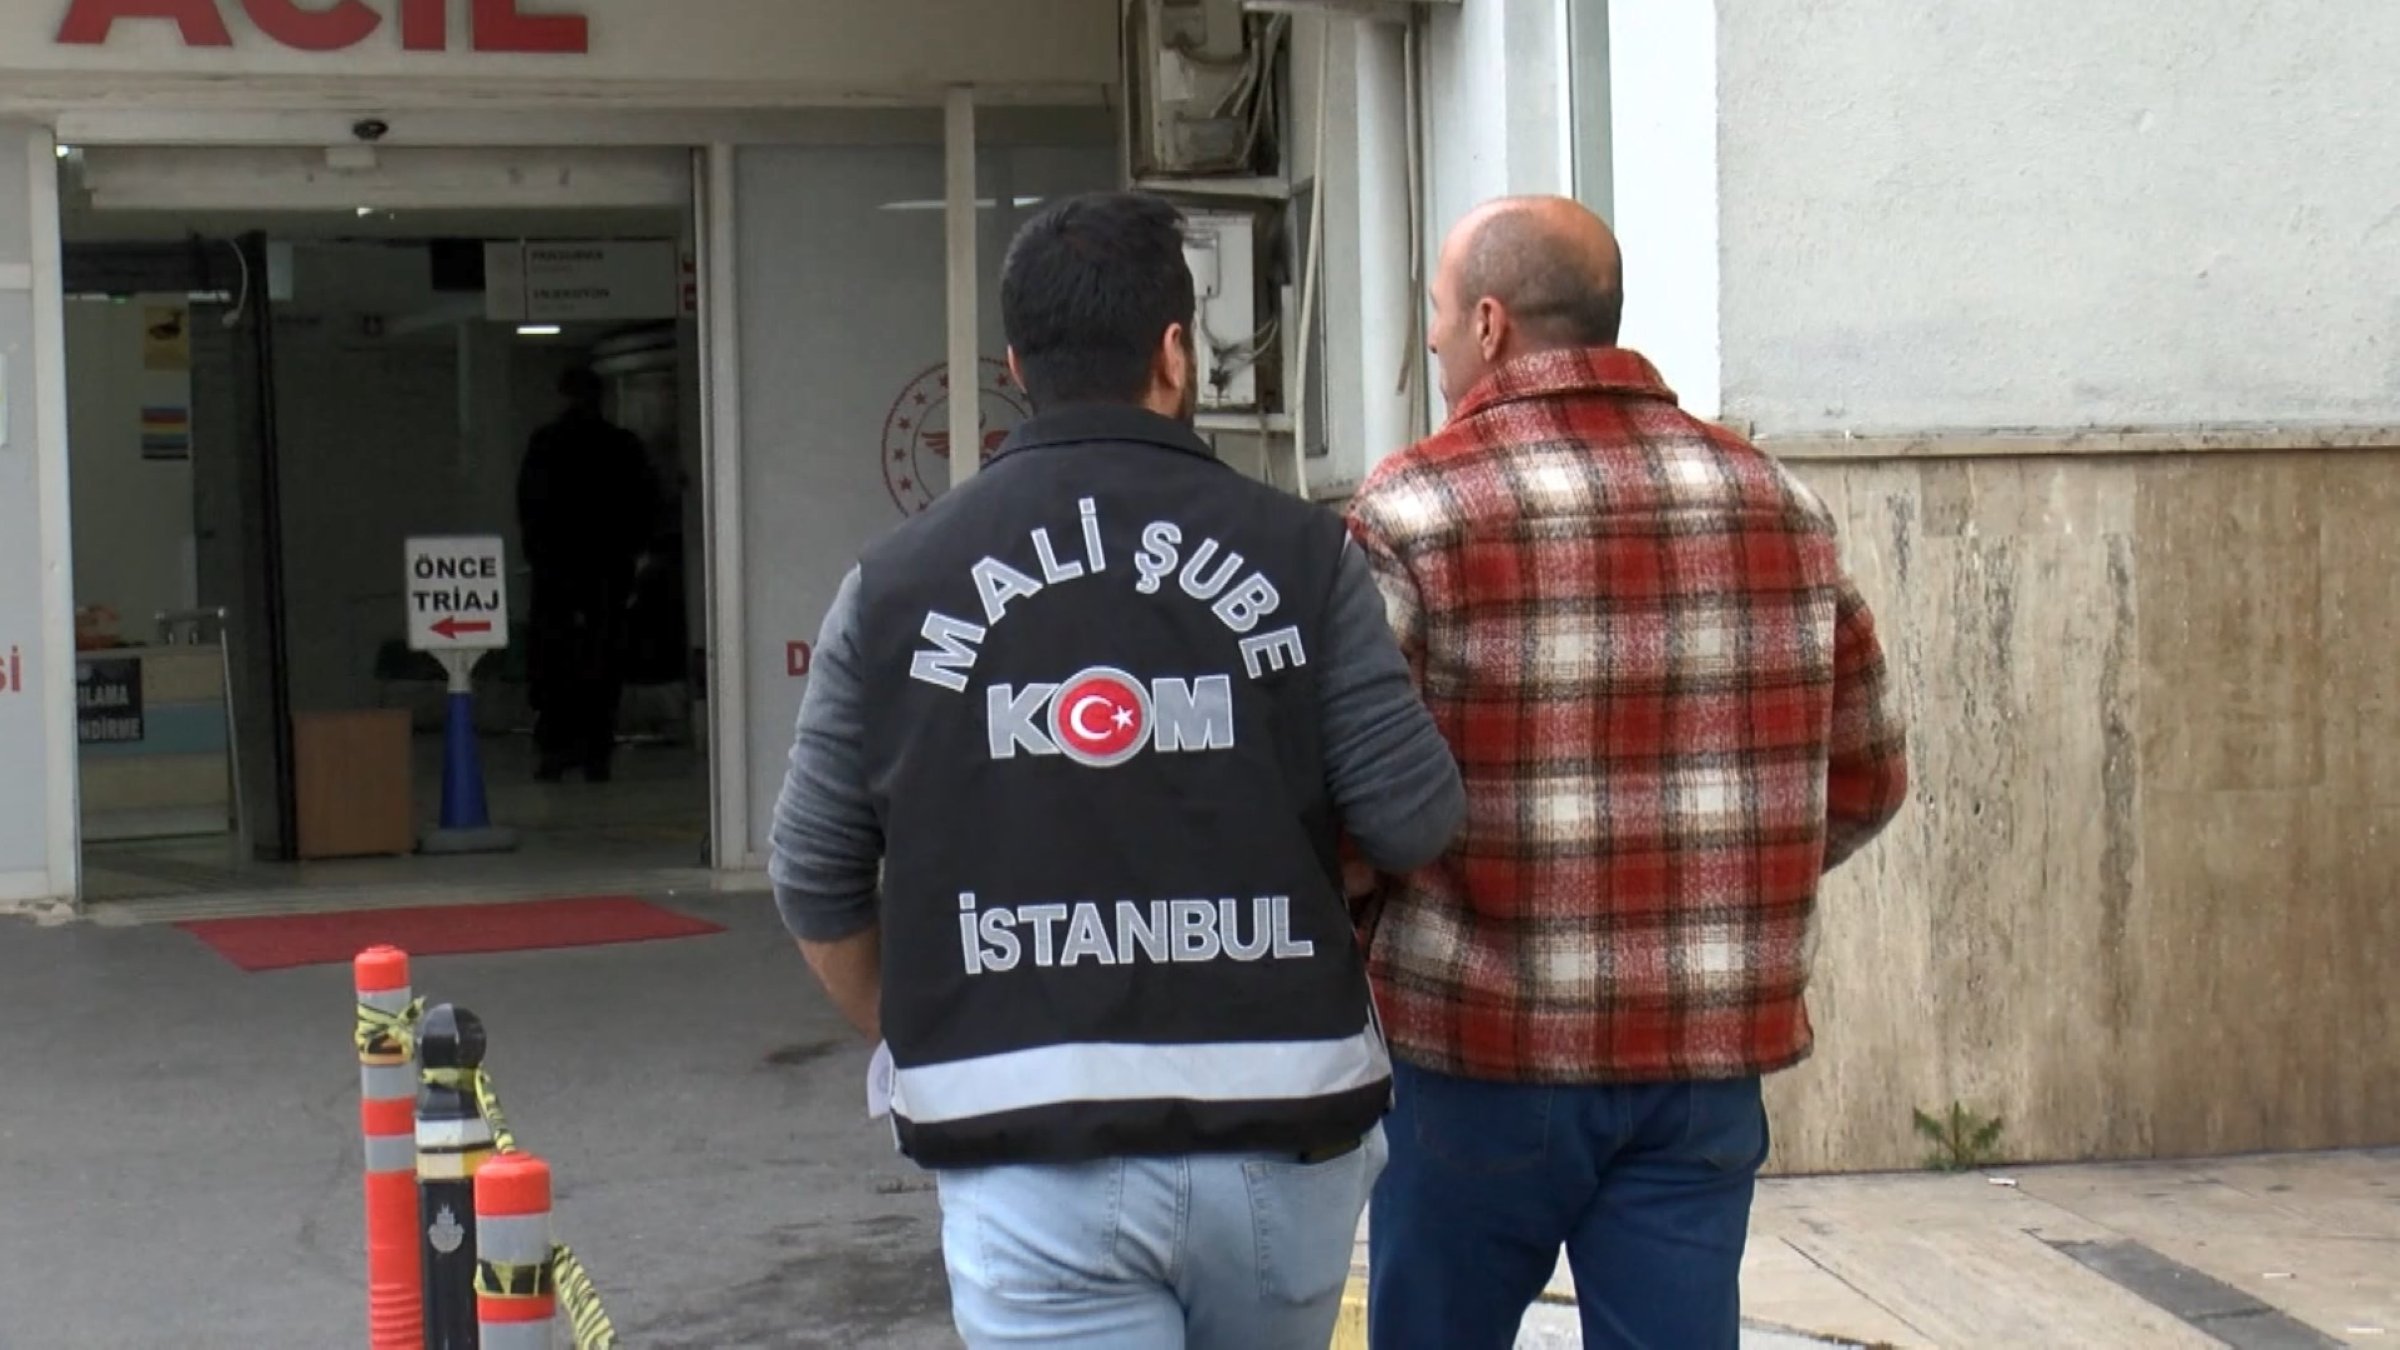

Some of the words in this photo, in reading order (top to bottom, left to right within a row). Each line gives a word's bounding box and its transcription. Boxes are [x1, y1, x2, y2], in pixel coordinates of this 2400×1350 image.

[413, 586, 499, 612] TRİAJ
[414, 553, 497, 579] ÖNCE
[909, 497, 1106, 692] MALİ
[1134, 520, 1306, 679] ŞUBE
[987, 665, 1234, 768] KOM
[958, 892, 1315, 974] İSTANBUL
